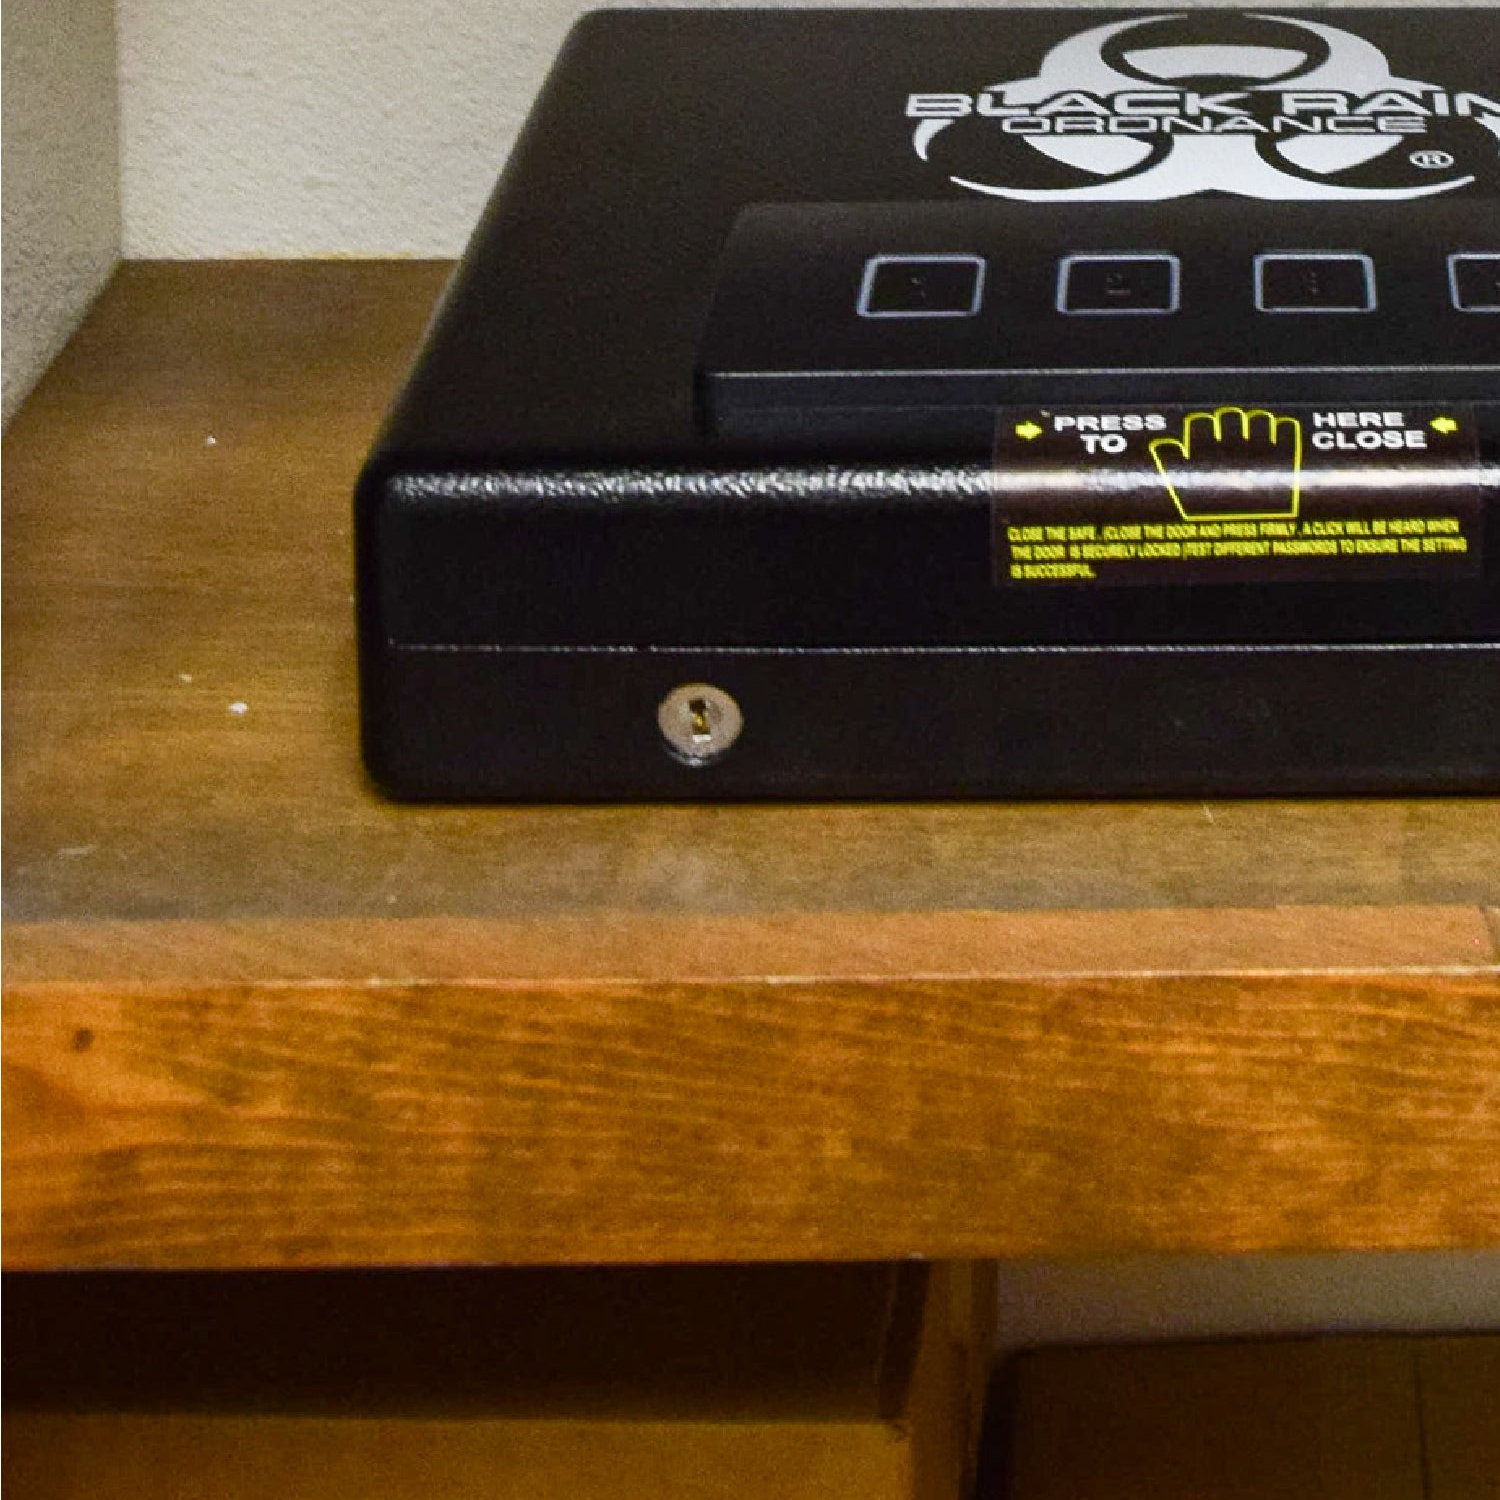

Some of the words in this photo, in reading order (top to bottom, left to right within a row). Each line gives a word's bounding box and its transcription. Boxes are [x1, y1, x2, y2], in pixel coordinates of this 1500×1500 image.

[905, 90, 1249, 117] BLACK
[1001, 116, 1428, 134] ORDNANCE
[1054, 414, 1167, 432] PRESS
[1312, 412, 1406, 429] HERE
[1081, 435, 1128, 454] TO
[1311, 431, 1428, 449] CLOSE
